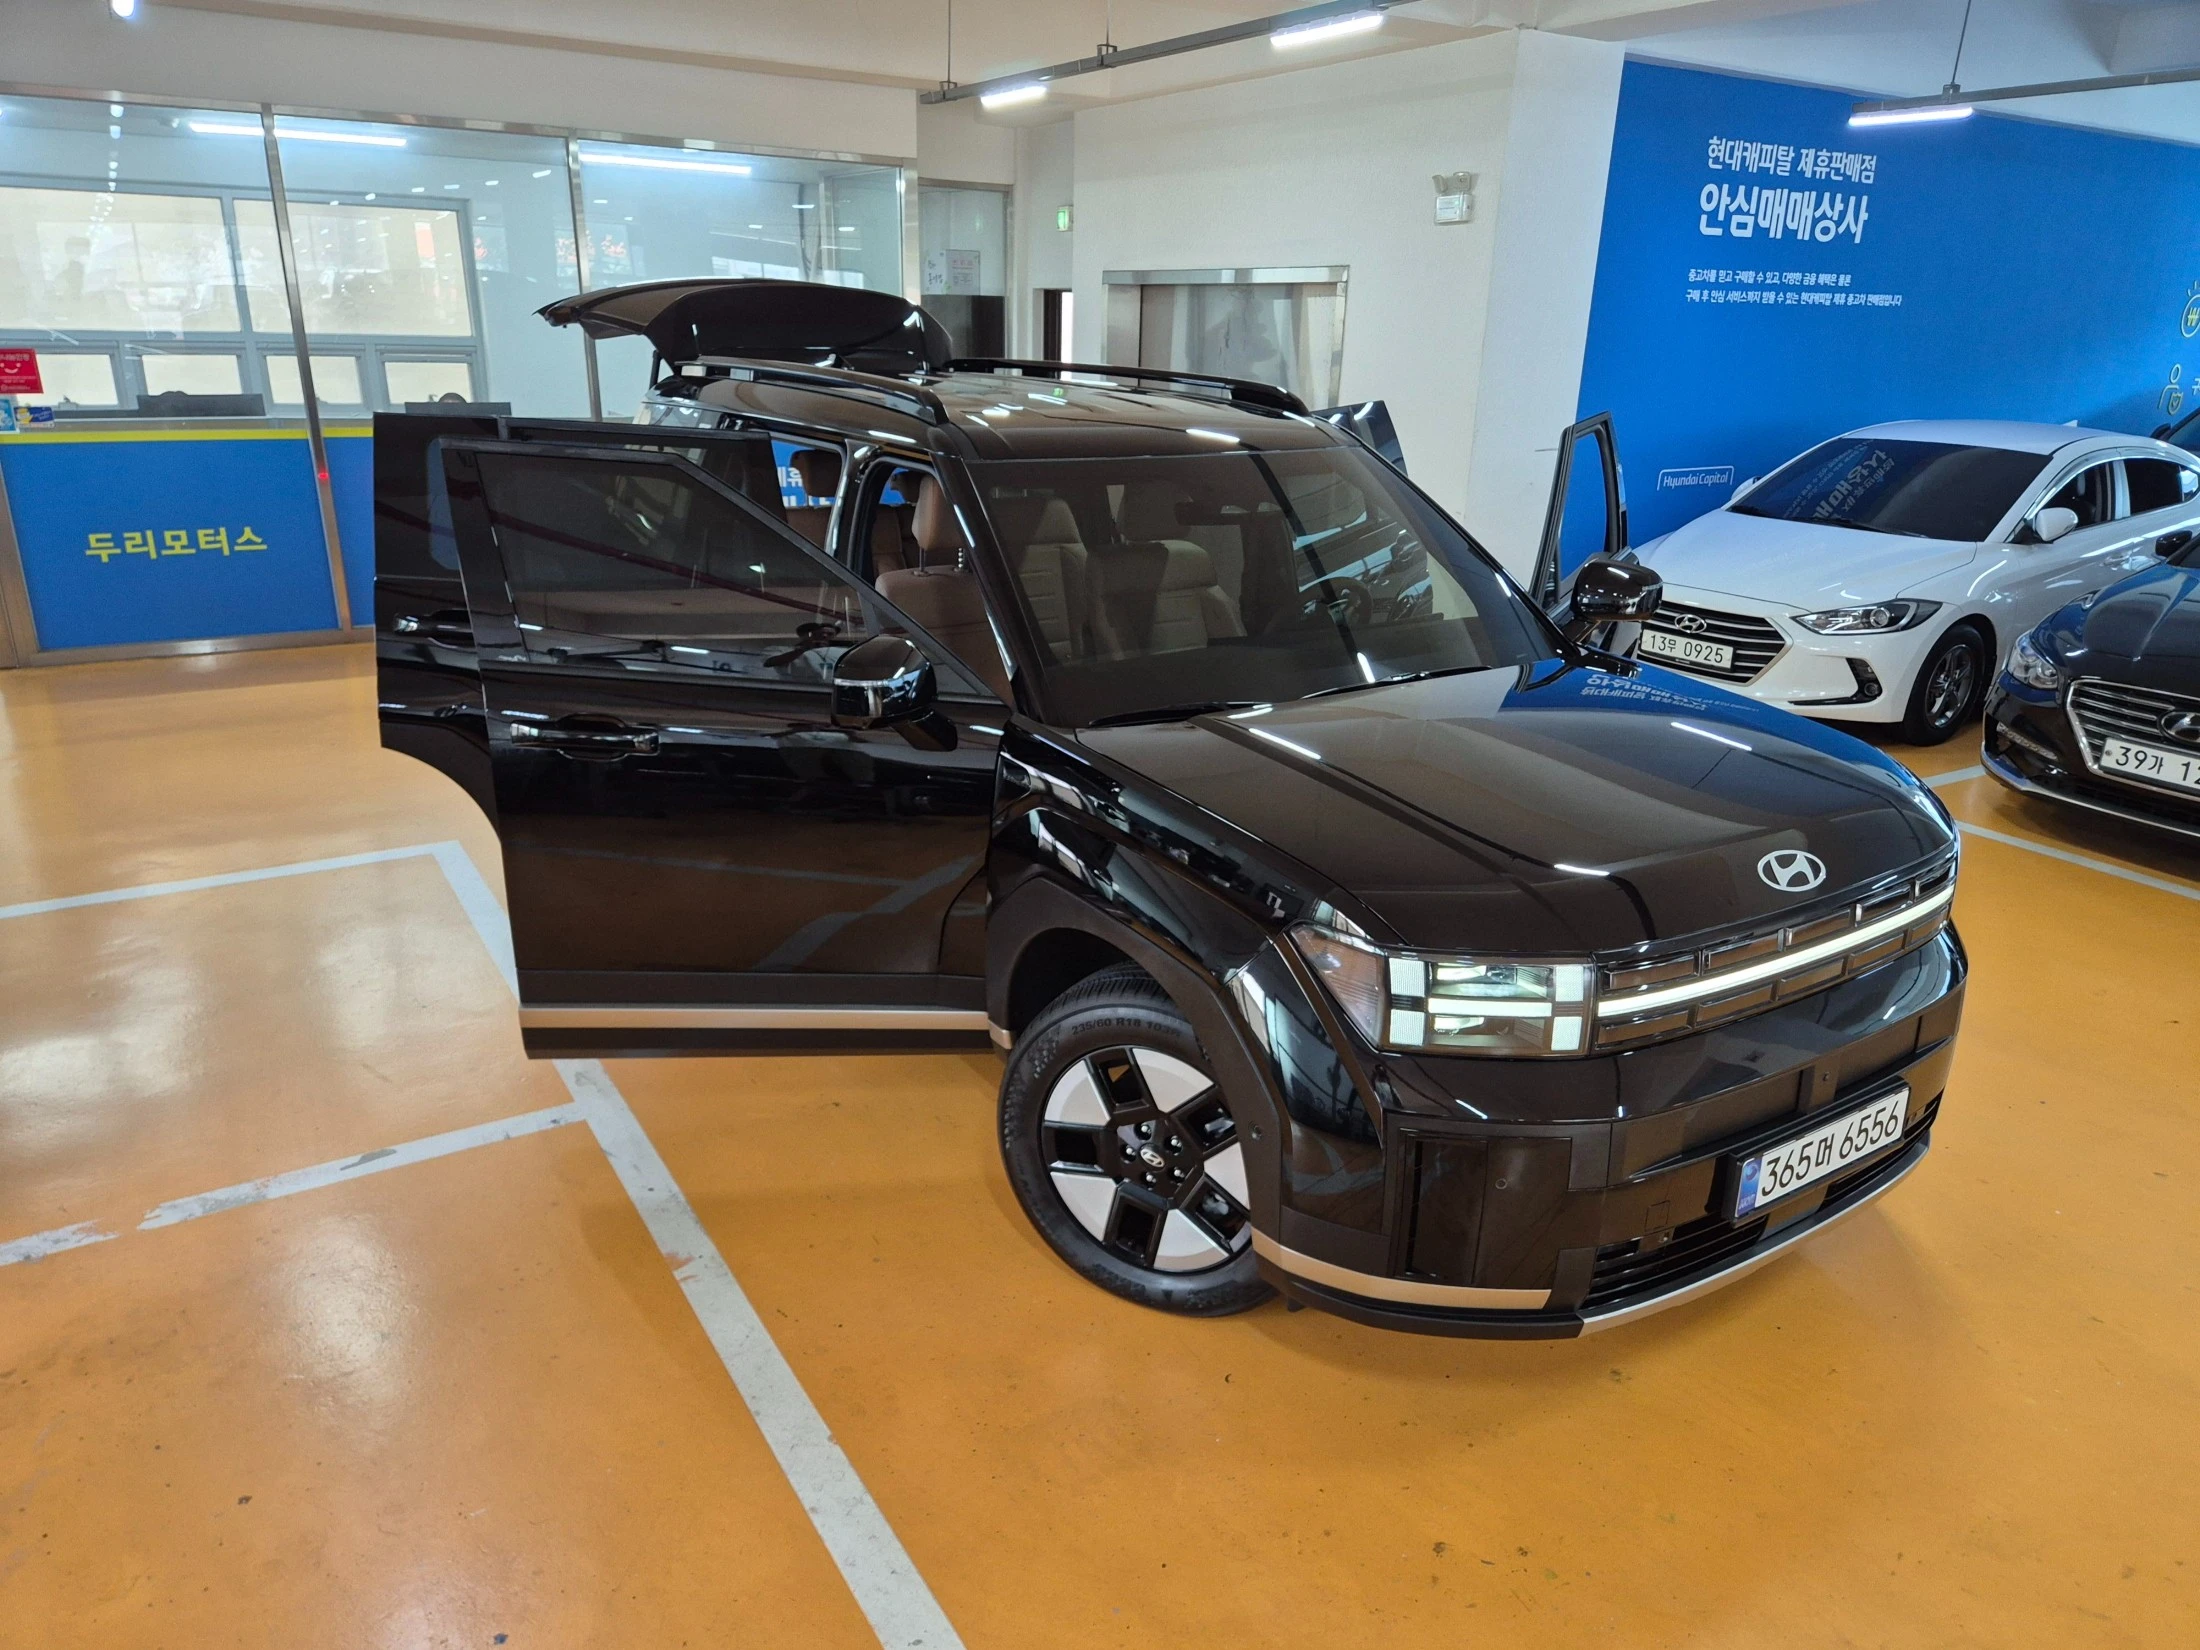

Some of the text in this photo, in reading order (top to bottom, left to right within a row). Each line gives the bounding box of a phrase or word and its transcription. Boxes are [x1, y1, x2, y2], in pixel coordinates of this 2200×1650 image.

[1708, 136, 1877, 184] 현대캐피탈 제휴판매점
[1699, 183, 1869, 244] 안심매매상사
[1688, 269, 1717, 283] 중고차를
[1718, 269, 1733, 283] 믿고
[1734, 270, 1756, 284] 구매할
[1756, 271, 1764, 284] 수
[1781, 272, 1802, 285] 다양한
[1803, 273, 1817, 286] 금융
[1685, 289, 1701, 302] 구매
[1701, 289, 1710, 302] 후
[1710, 290, 1726, 303] 안심
[1726, 290, 1761, 304] 서비스까지
[1761, 291, 1776, 304] 받을
[1777, 291, 1785, 304] 수
[1785, 292, 1799, 305] 있는
[1833, 293, 1847, 306] 제휴
[1847, 293, 1866, 306] 중고차
[1663, 471, 1729, 490] Hyundai Capital
[85, 526, 268, 563] 두리모터스
[1650, 634, 1724, 664] 13무 0925
[2115, 746, 2164, 775] 39가
[1072, 1018, 1112, 1036] 235/60
[1116, 1017, 1141, 1028] R18
[1761, 1101, 1899, 1197] 365머 6556
